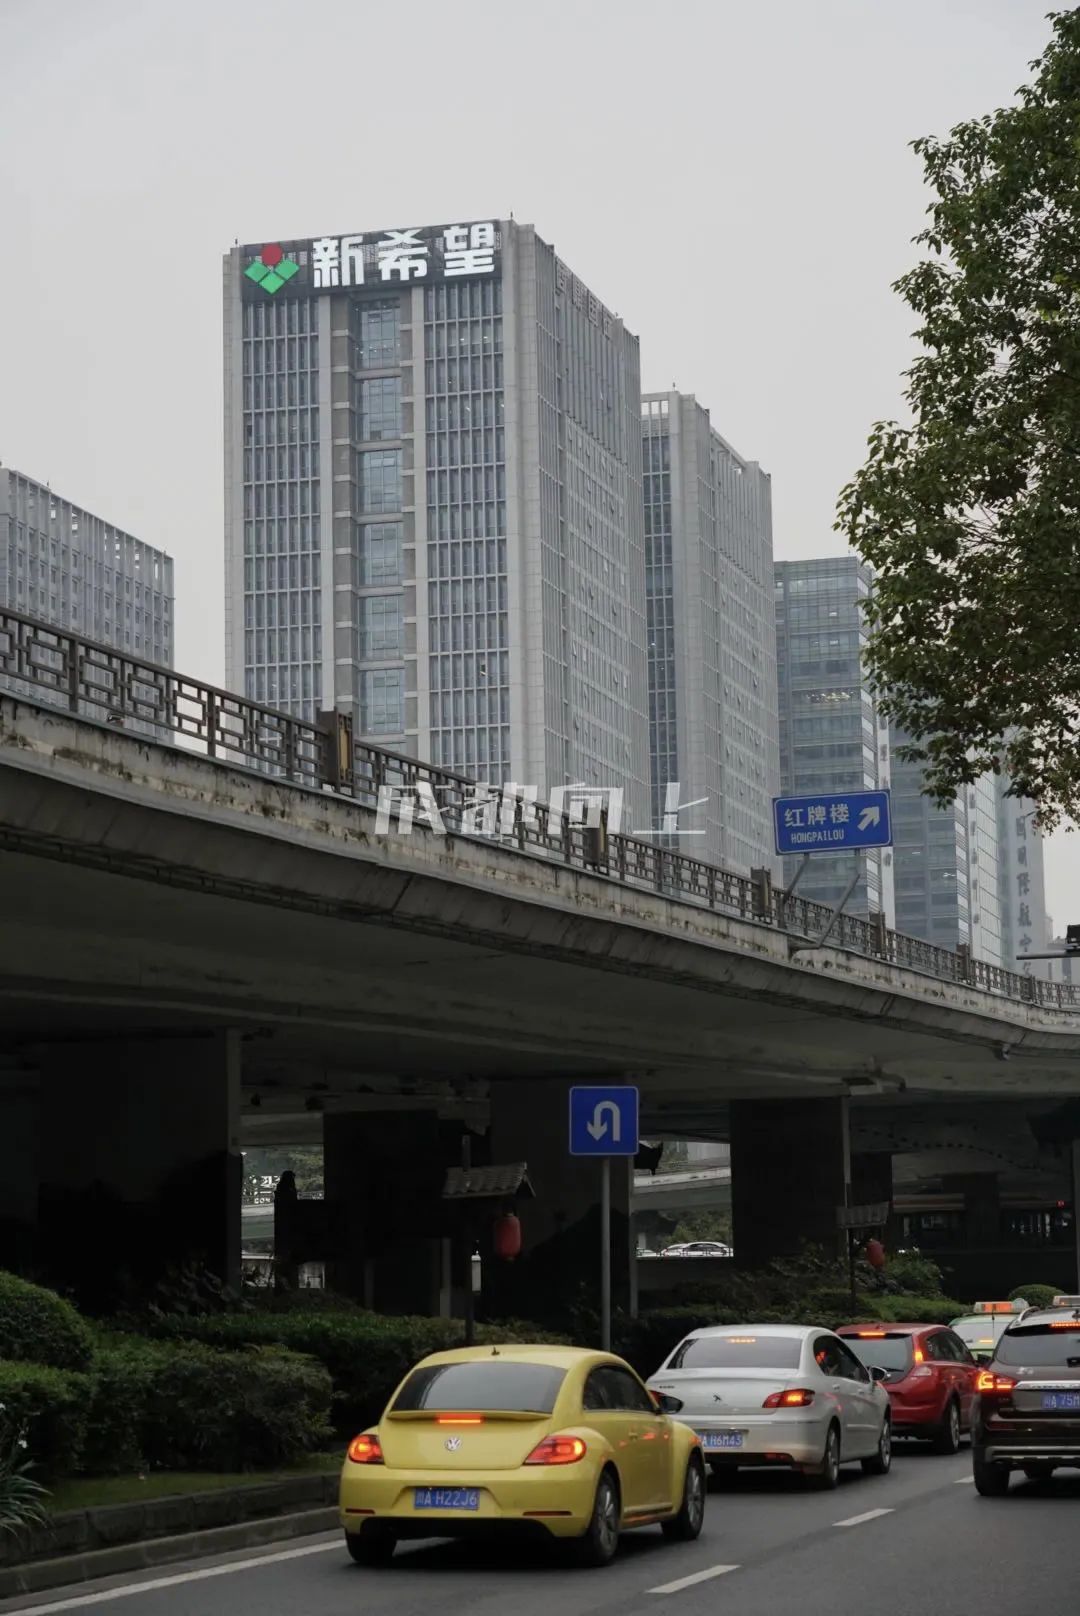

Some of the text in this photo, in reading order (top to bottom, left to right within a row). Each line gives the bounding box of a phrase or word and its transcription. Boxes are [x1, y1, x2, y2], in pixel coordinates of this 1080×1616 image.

[313, 222, 495, 288] 新希望
[784, 803, 850, 827] 红牌楼
[791, 830, 845, 844] HONGPAILOU
